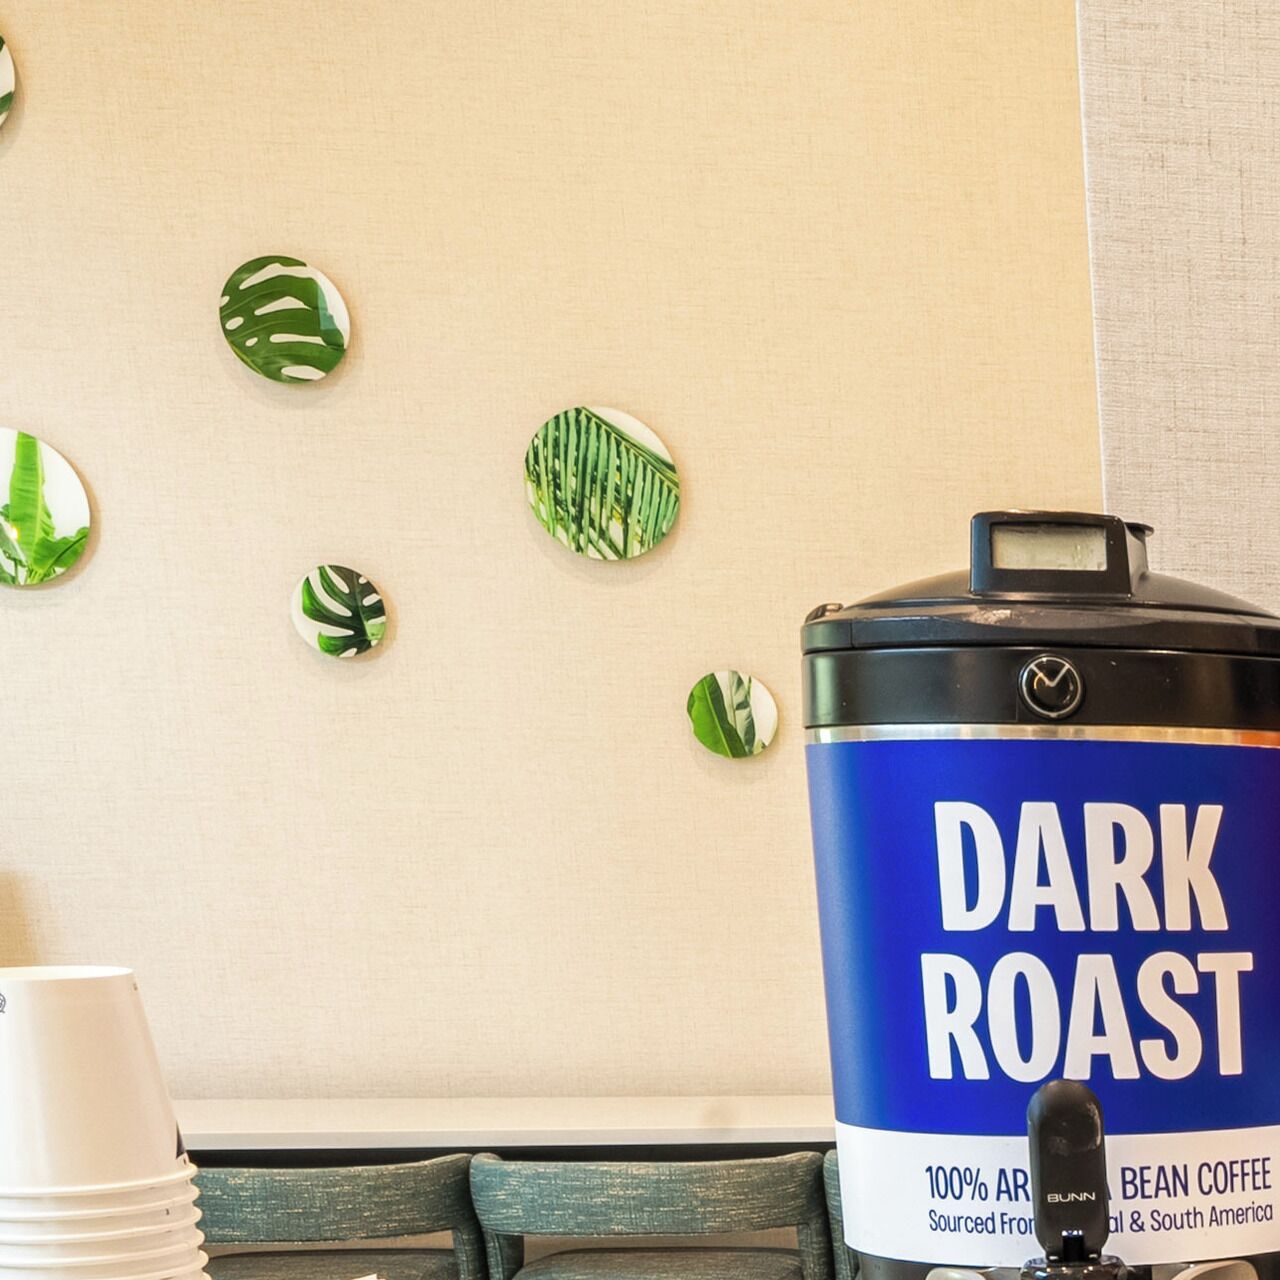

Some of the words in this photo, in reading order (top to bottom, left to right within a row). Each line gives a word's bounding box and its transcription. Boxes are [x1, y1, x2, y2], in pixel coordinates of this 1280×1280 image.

[934, 801, 1230, 932] DARK
[921, 951, 1254, 1083] ROAST
[925, 1165, 988, 1201] 100%
[1120, 1164, 1189, 1200] BEAN
[1199, 1157, 1272, 1196] COFFEE
[1047, 1192, 1096, 1203] BUNN
[929, 1209, 996, 1234] Sourced
[1130, 1210, 1145, 1233] &
[1150, 1207, 1204, 1233] South
[1208, 1201, 1273, 1230] America
